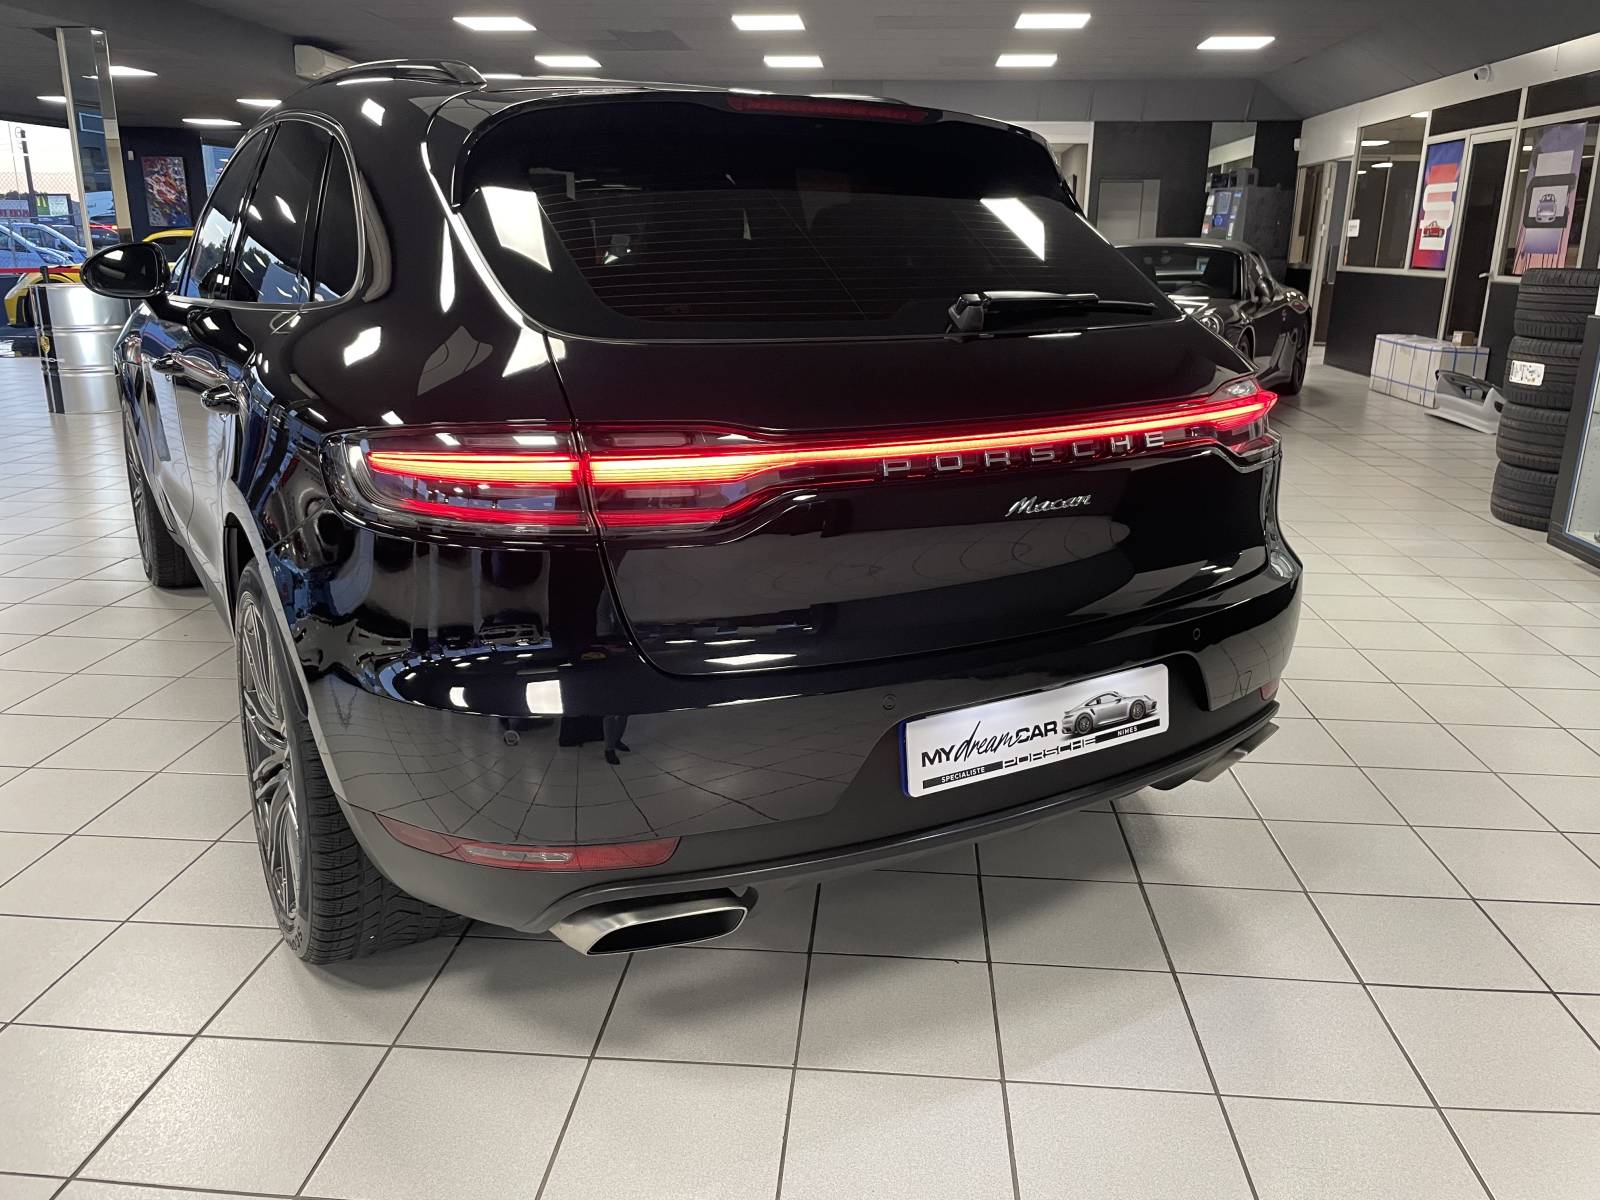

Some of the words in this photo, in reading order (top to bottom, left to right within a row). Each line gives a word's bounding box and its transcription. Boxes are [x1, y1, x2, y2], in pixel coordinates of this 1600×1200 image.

[882, 431, 1166, 477] PORSCHE
[1004, 494, 1092, 518] Macan
[921, 745, 955, 767] MY
[941, 766, 985, 783] SPECIALISTE
[1002, 738, 1096, 769] PORSCHE
